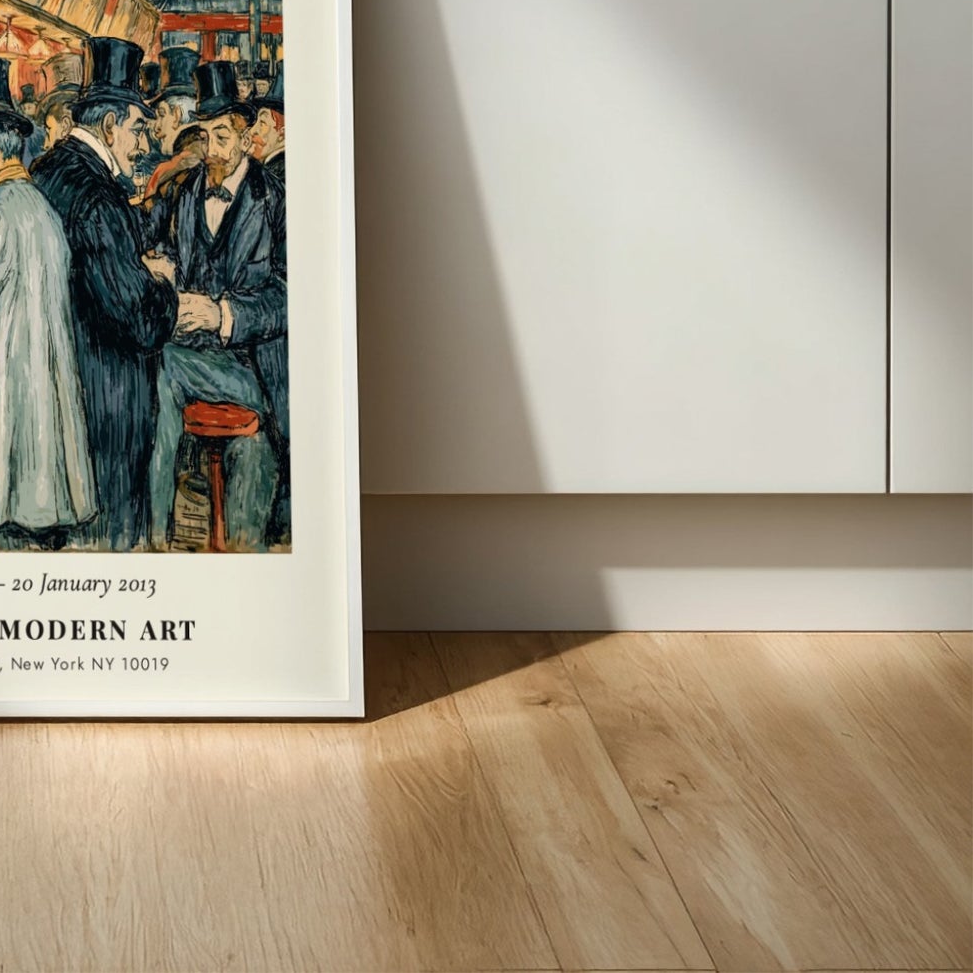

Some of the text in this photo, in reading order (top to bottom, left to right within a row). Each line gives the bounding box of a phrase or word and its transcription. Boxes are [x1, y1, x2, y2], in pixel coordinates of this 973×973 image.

[11, 578, 34, 592] 20
[39, 572, 112, 599] January
[118, 578, 157, 599] 2013
[0, 619, 127, 641] MODERN
[139, 619, 196, 641] ART
[11, 657, 45, 671] New
[51, 656, 85, 671] York
[92, 657, 115, 671] NY
[122, 657, 169, 671] 10019
